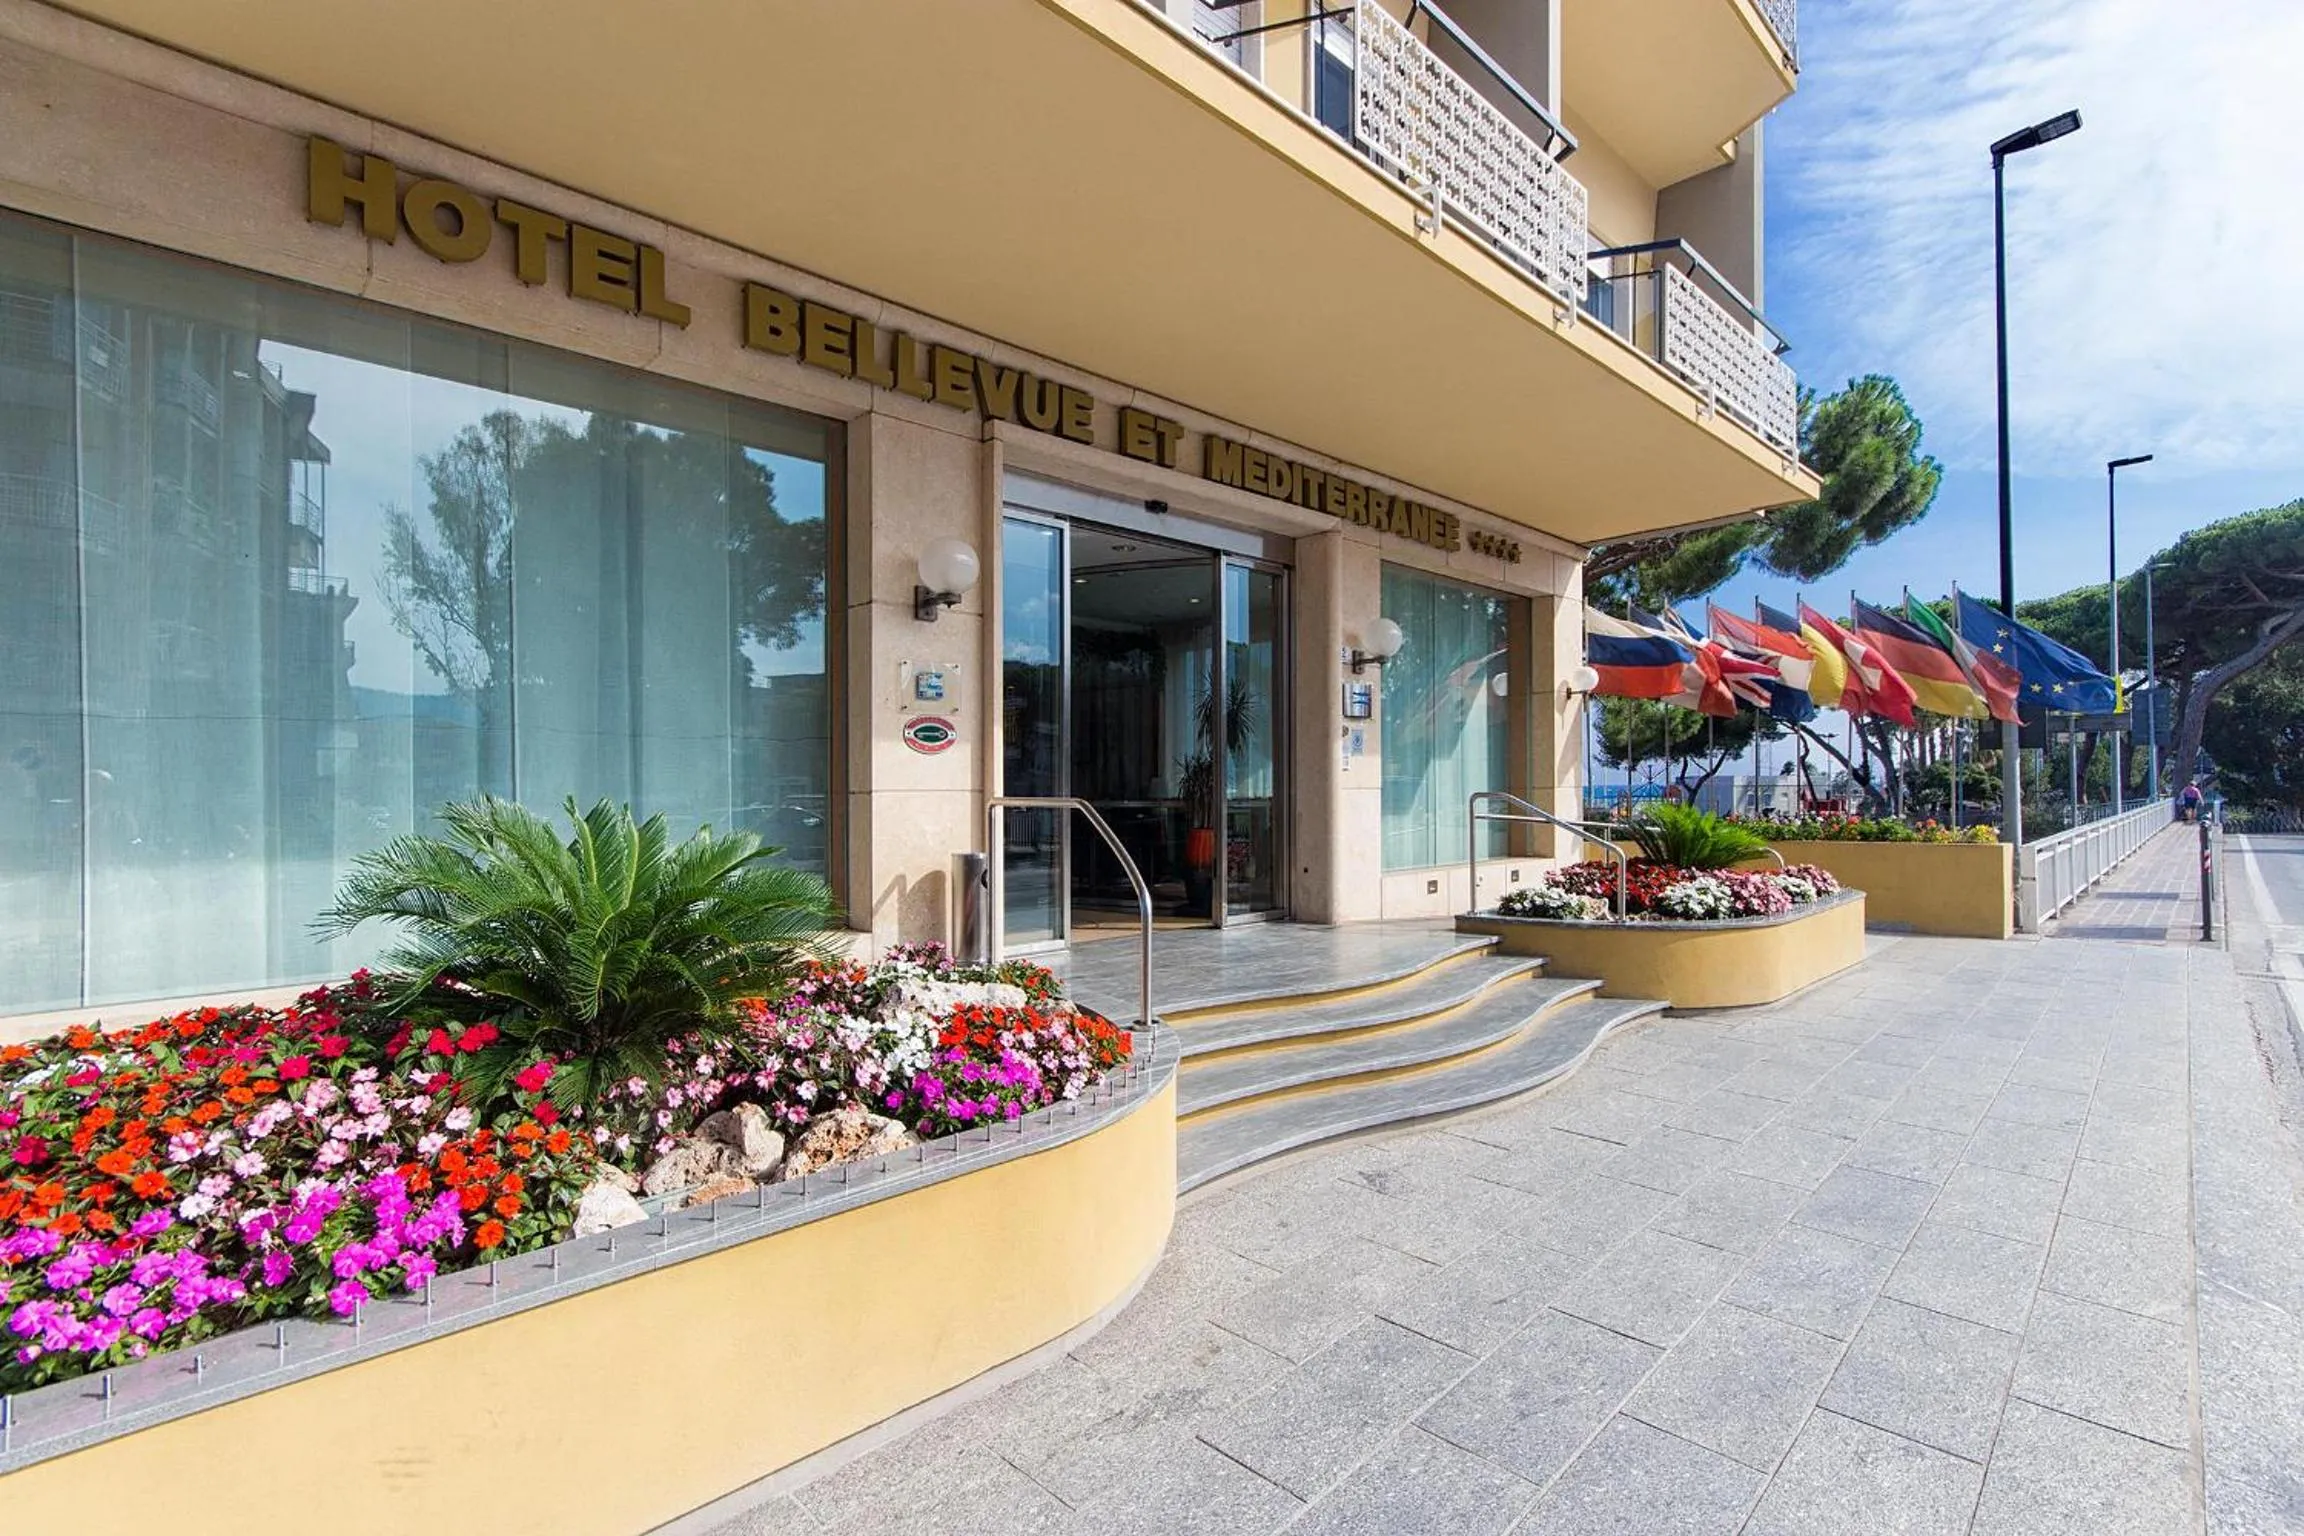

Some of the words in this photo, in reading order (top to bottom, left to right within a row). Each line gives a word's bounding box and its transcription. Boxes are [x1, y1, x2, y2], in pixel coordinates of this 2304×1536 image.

[305, 134, 691, 329] HOTEL
[741, 281, 1095, 444] BELLEVUE
[1119, 407, 1184, 469] ET
[1203, 434, 1461, 553] MEDITERRANEE
